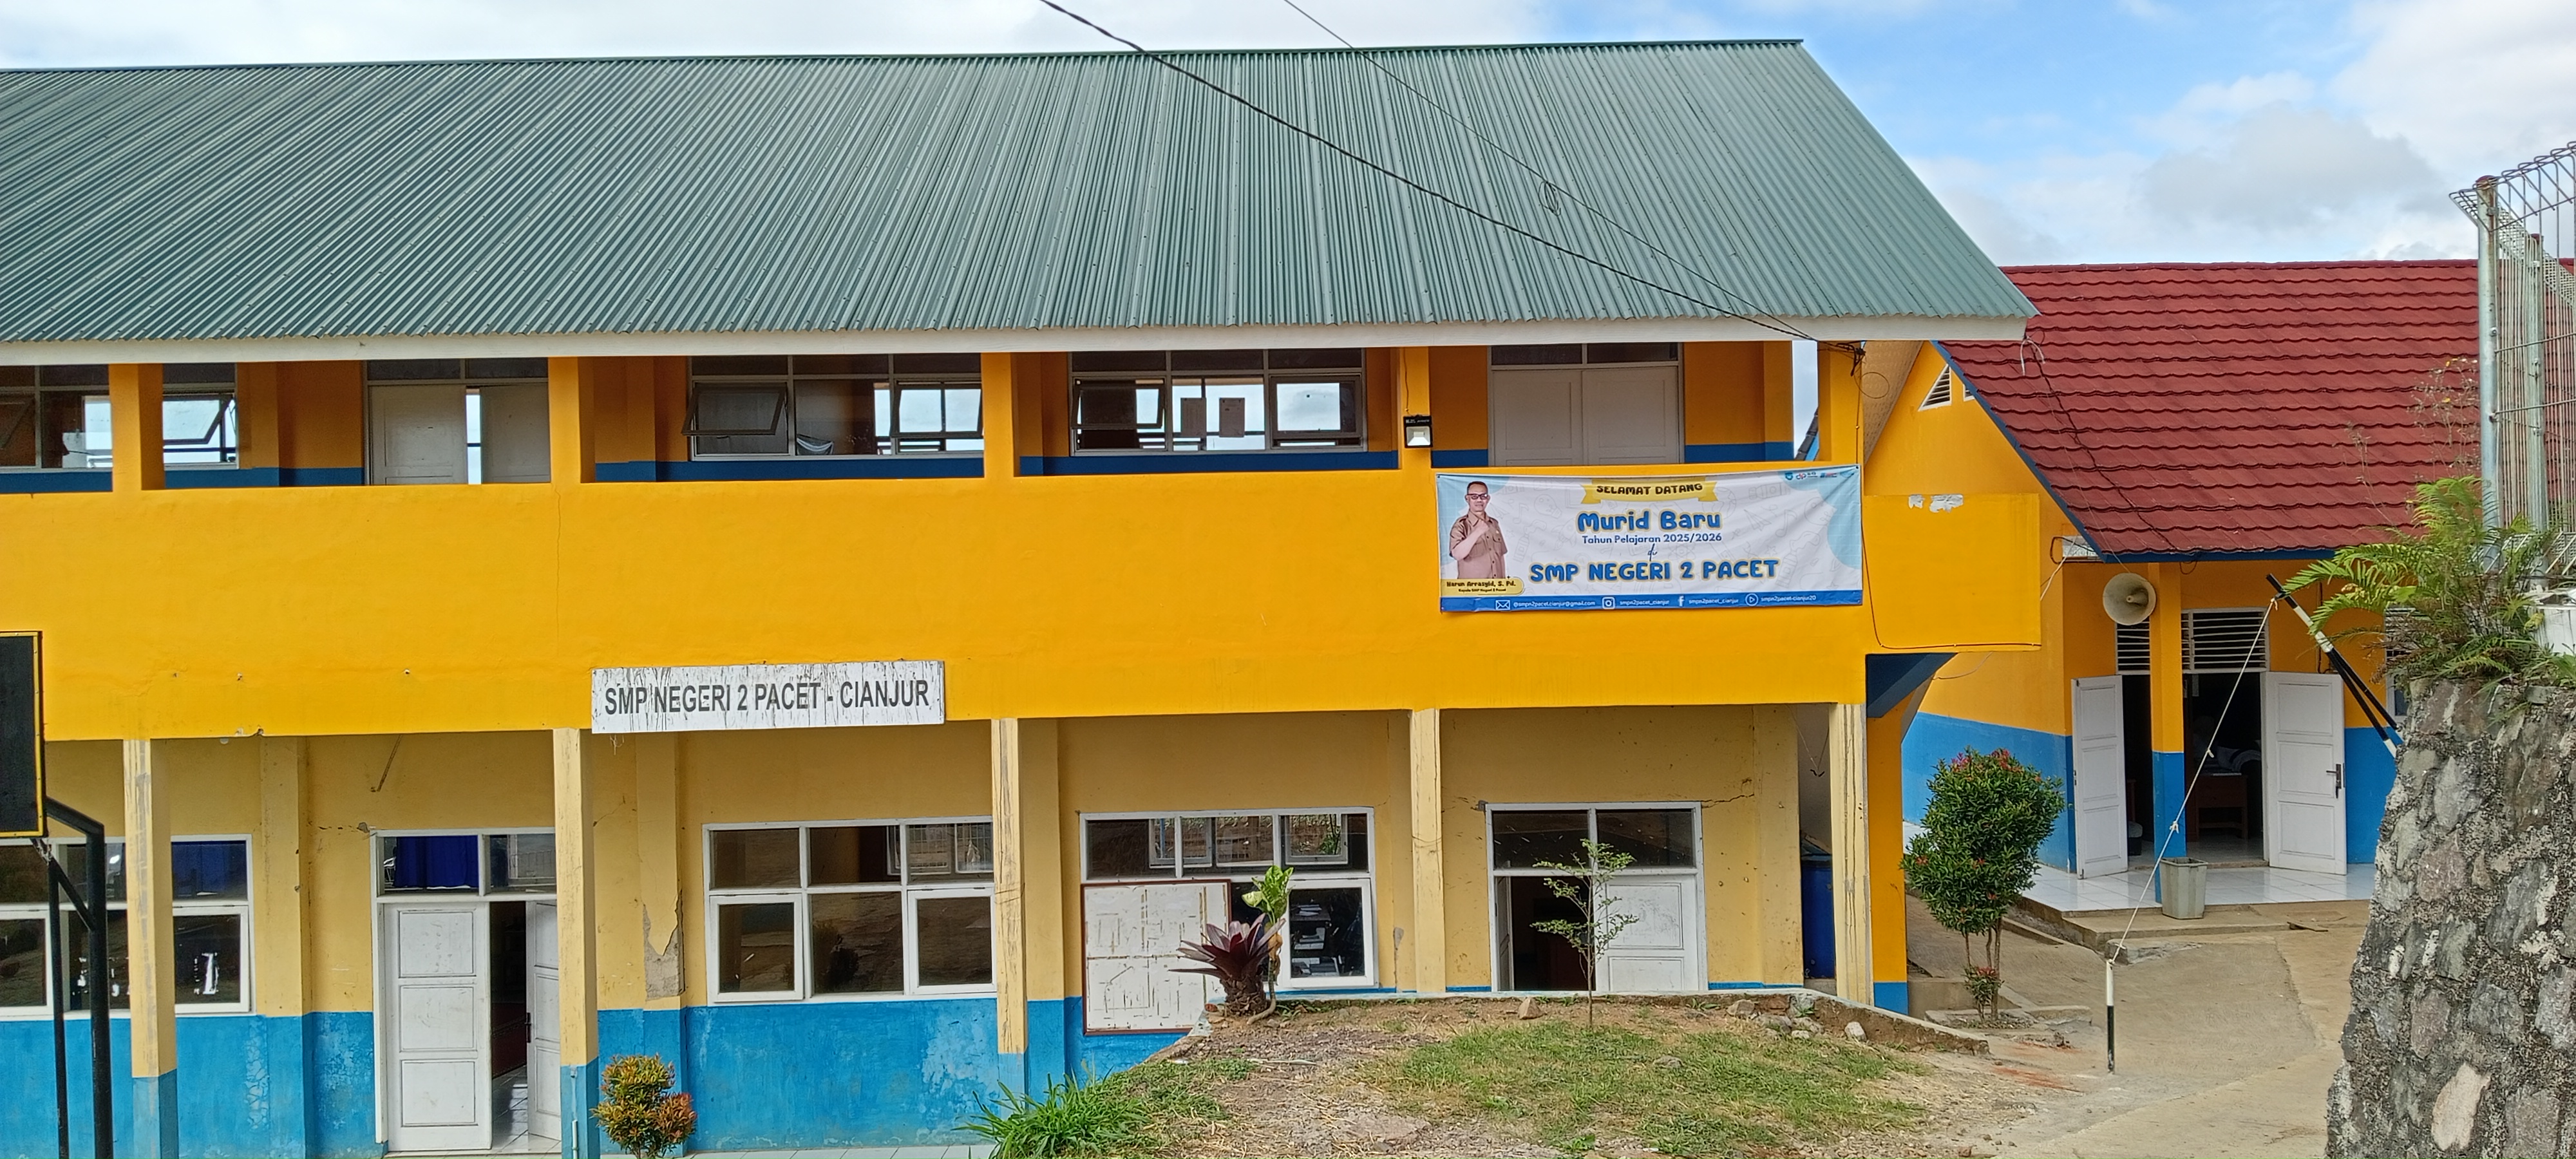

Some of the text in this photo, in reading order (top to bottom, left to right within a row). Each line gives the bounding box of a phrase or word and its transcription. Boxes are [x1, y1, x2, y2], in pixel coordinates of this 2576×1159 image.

[1596, 483, 1703, 495] SELAMAT DATANG
[1577, 510, 1721, 532] Murid Baru
[1582, 532, 1722, 545] Tahun Pelajaran 2025/2026
[1530, 559, 1780, 581] SMP NEGERI 2 PACET
[605, 686, 647, 715] SMP
[654, 684, 730, 713] NEGERI
[737, 684, 748, 711] 2
[755, 682, 821, 710] PACET
[840, 680, 929, 708] CIANJUR
